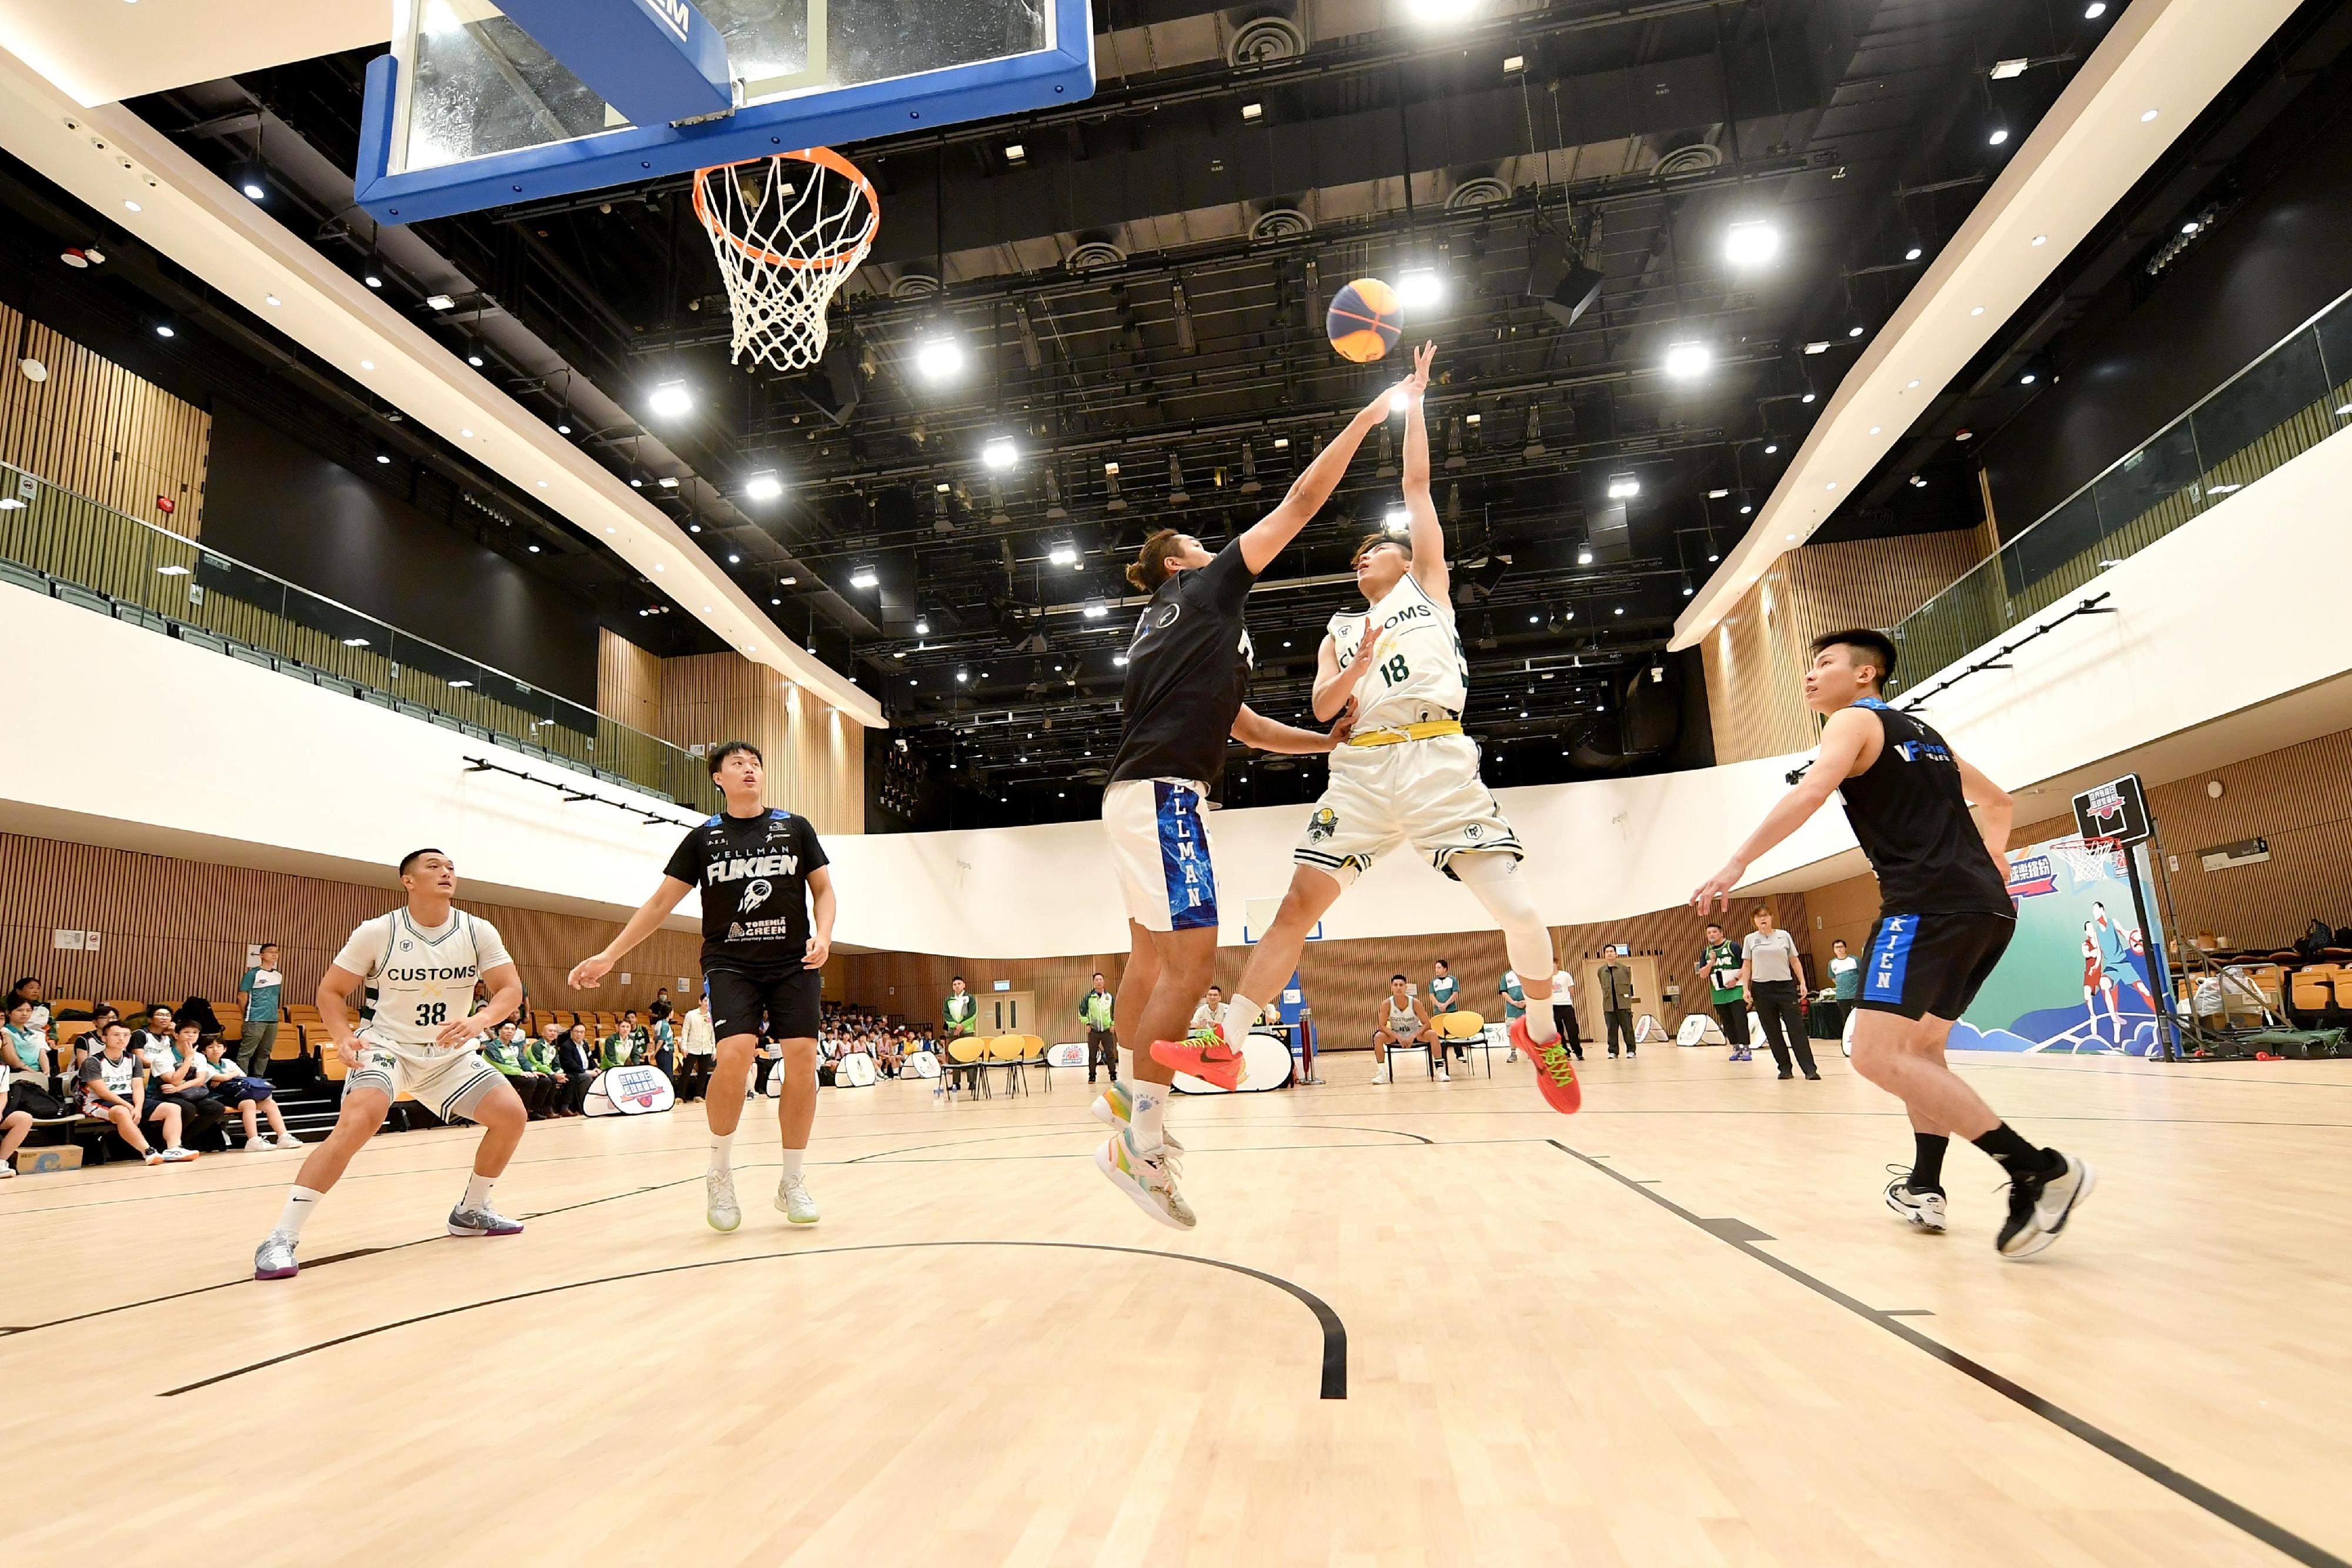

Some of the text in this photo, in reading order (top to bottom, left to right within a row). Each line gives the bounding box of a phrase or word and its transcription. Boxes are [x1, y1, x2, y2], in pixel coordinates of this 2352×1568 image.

[1339, 605, 1431, 668] CUOMS
[1380, 654, 1410, 688] 18
[711, 845, 789, 861] WELLMAN
[707, 855, 799, 886] FUKIEN
[745, 926, 786, 936] GREEN
[387, 965, 476, 981] CUSTOMS
[415, 1002, 446, 1026] 38
